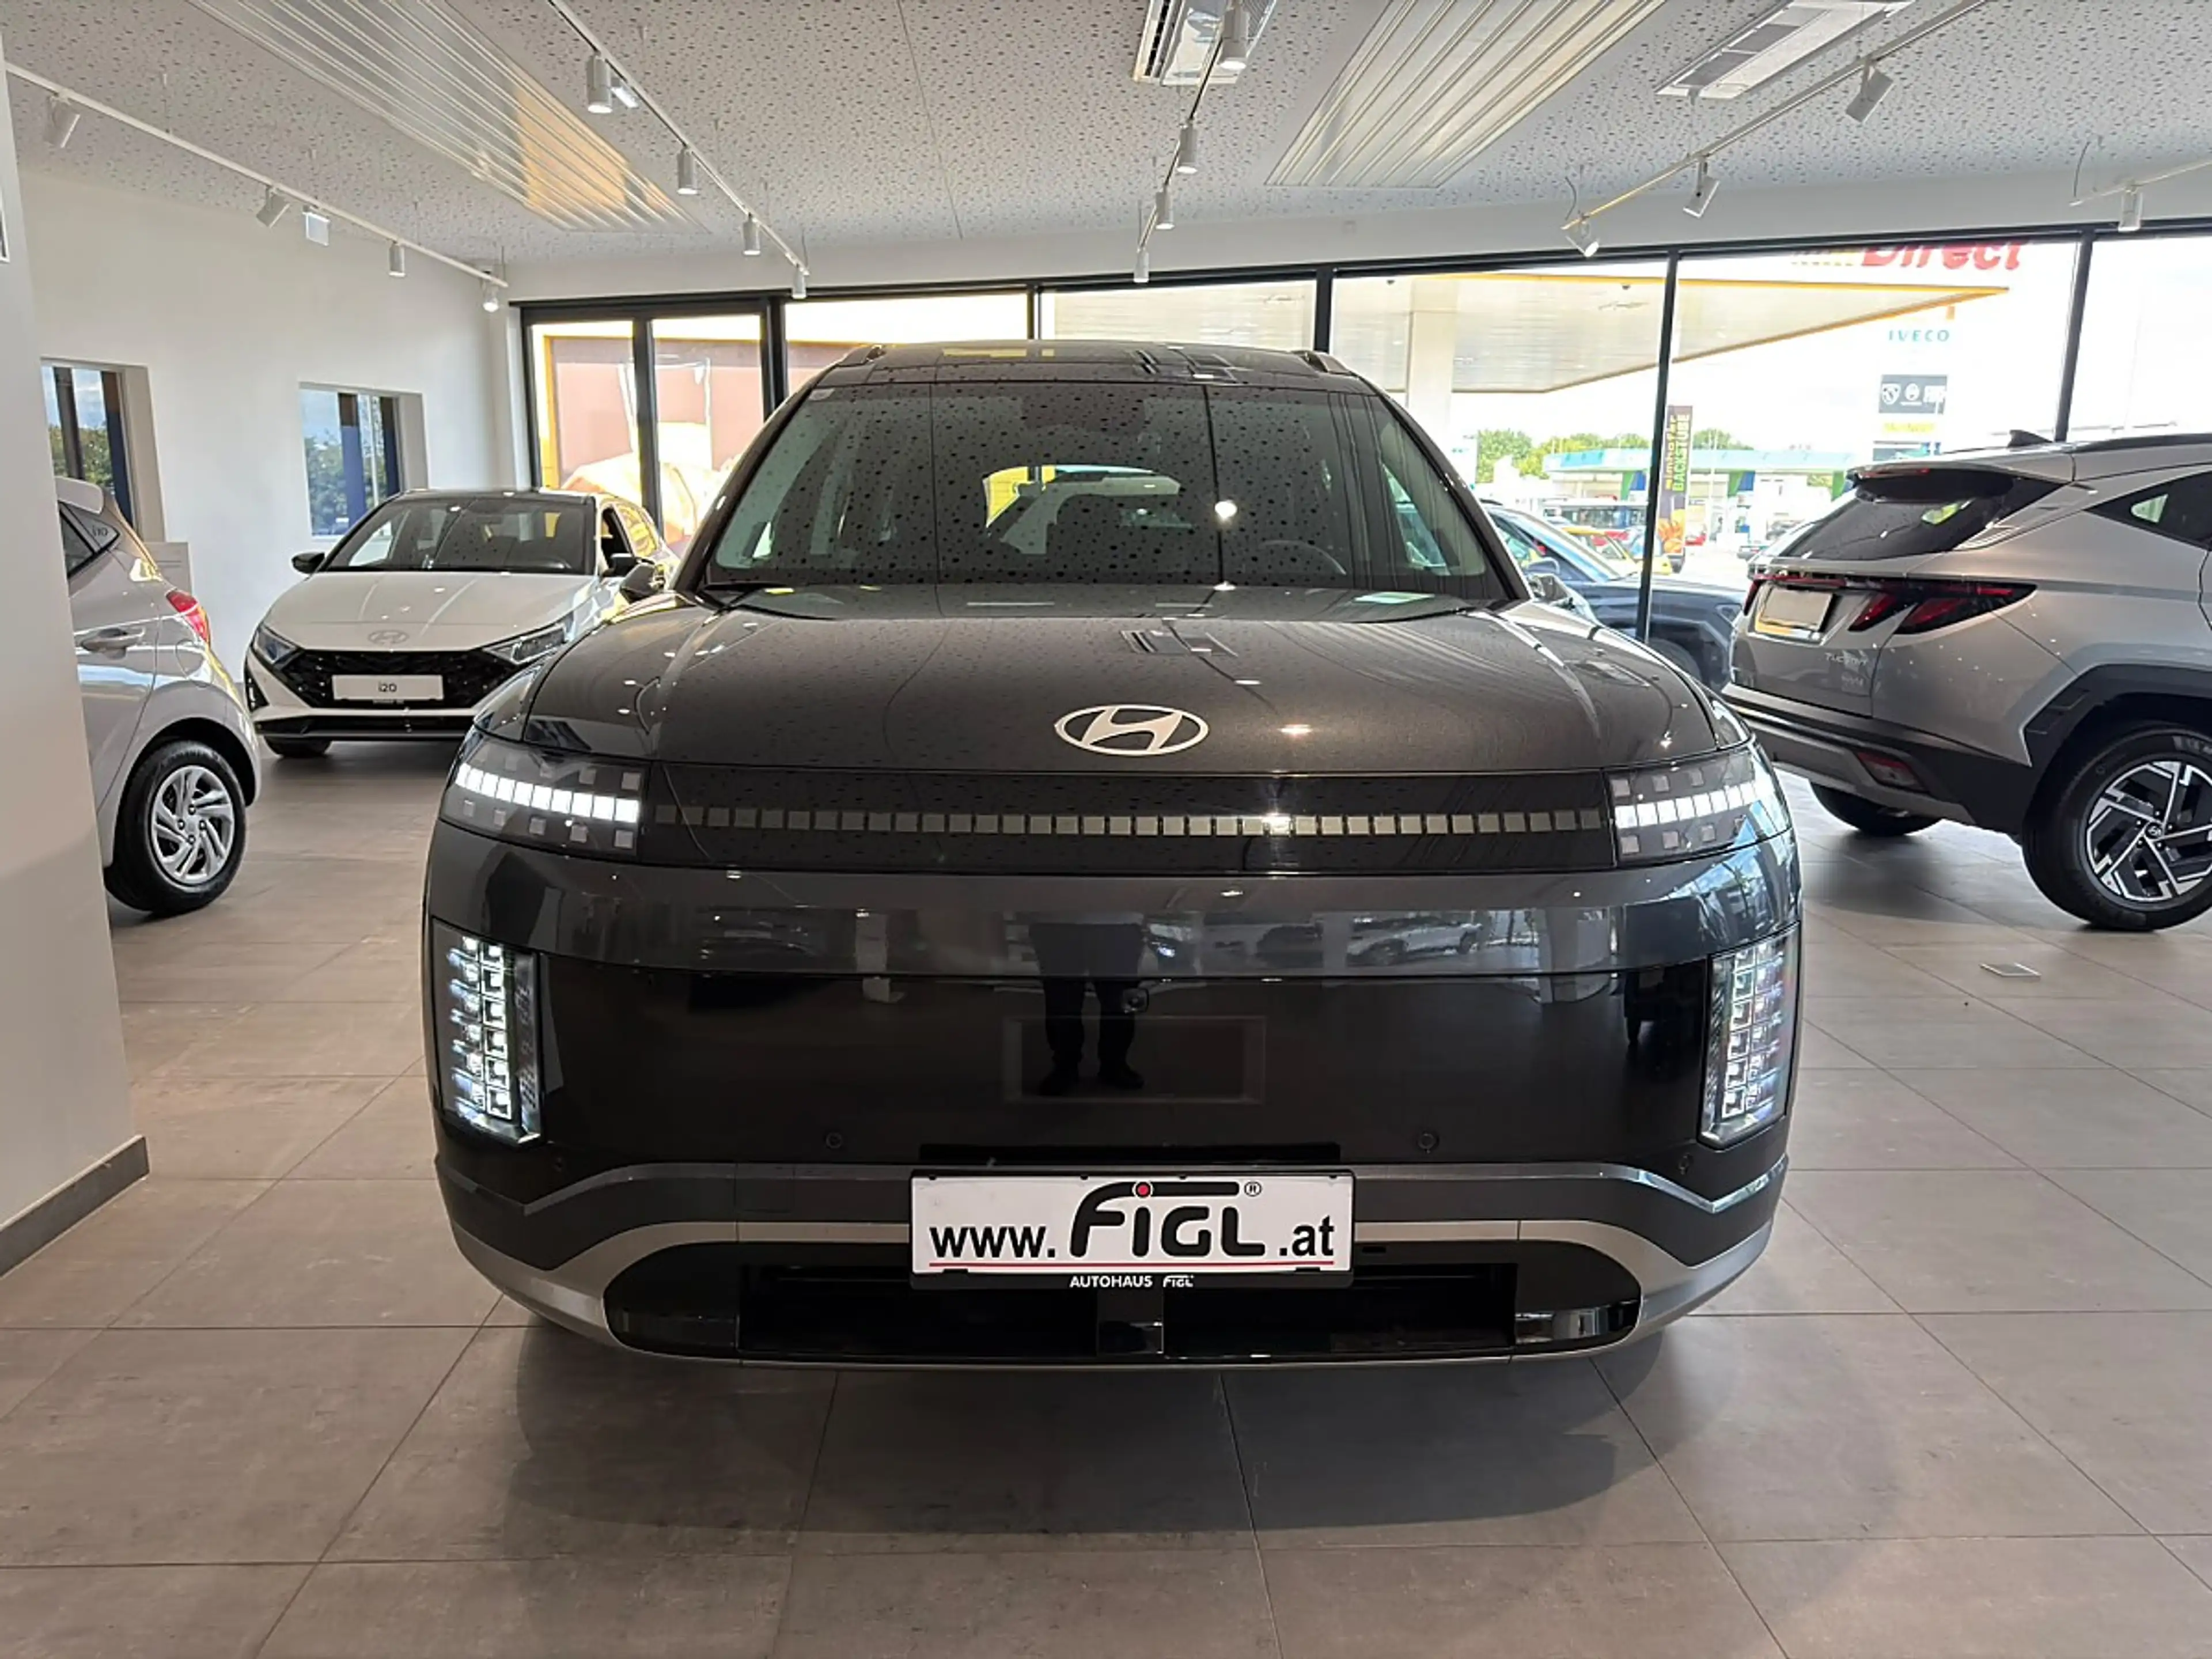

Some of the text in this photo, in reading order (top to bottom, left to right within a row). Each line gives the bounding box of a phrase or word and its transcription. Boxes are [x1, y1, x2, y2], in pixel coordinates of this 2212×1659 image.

[1889, 329, 1950, 342] IVECO
[1673, 415, 1690, 491] BACKSTUBE
[378, 681, 397, 692] i20
[1069, 1275, 1153, 1288] AUTOHAUS
